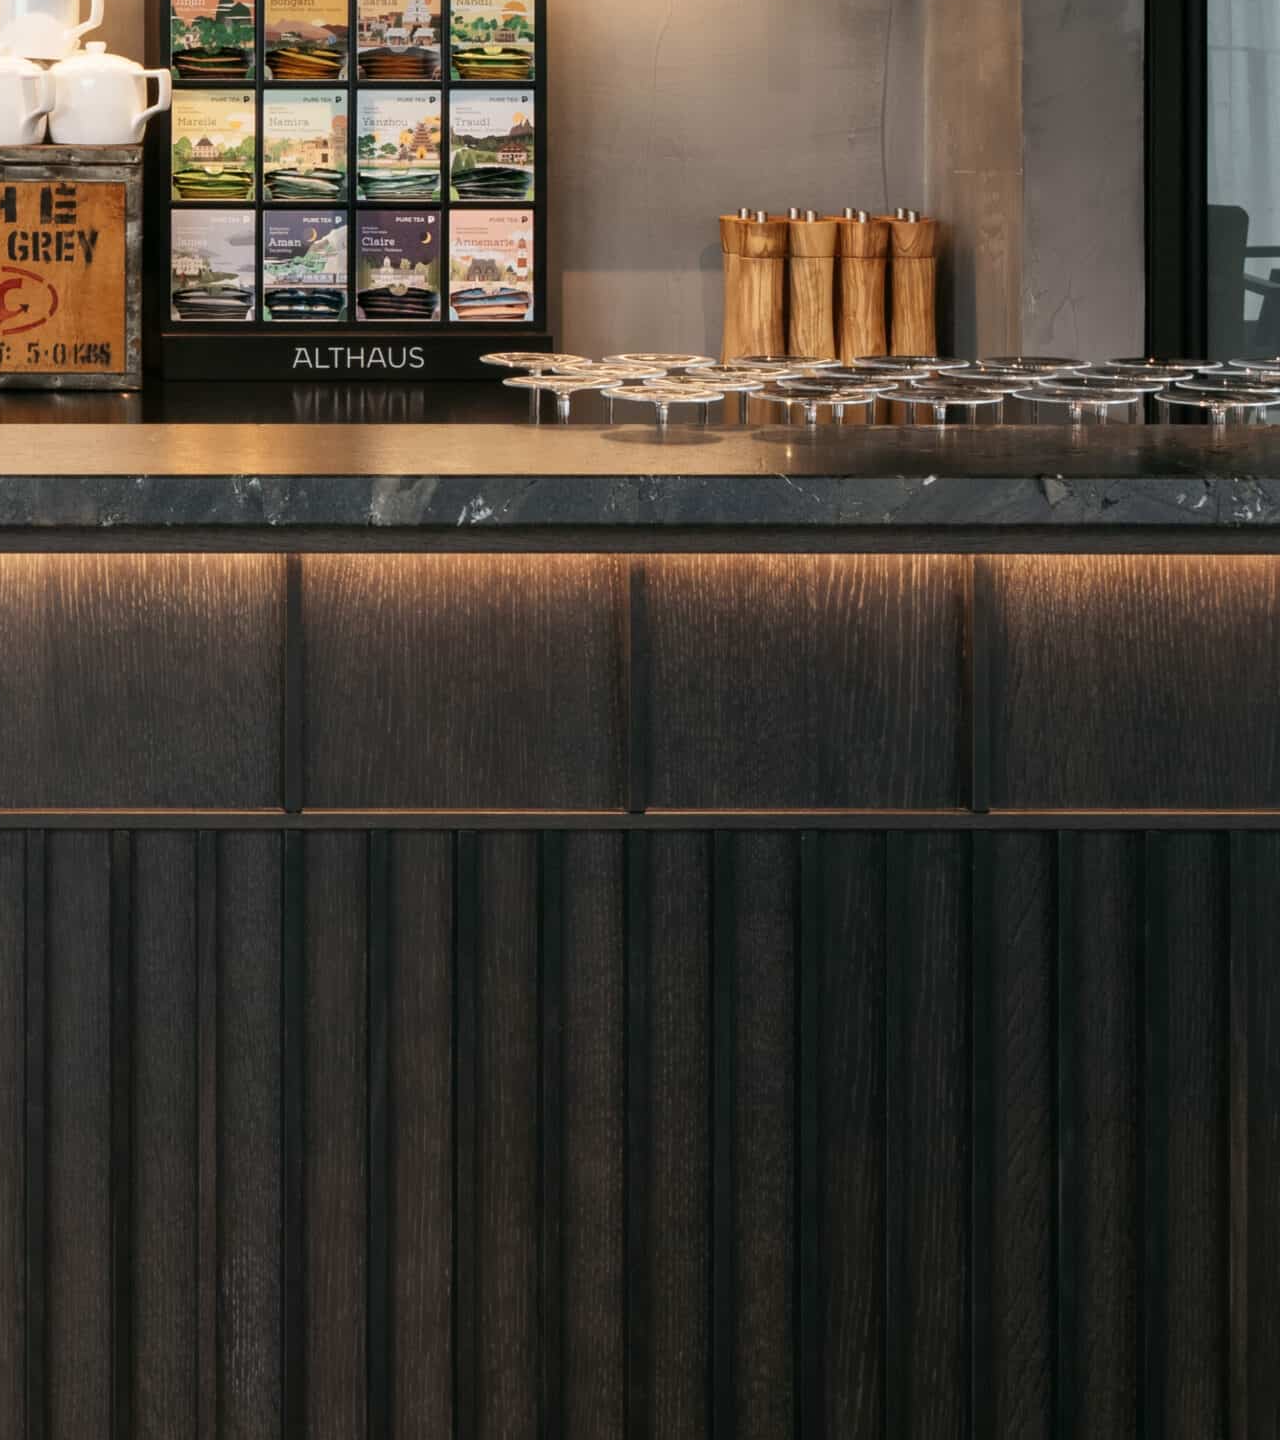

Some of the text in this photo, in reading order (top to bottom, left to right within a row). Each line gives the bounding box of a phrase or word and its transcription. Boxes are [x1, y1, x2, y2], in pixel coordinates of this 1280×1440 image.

[7, 229, 99, 264] GREY
[267, 237, 302, 248] Aman
[361, 236, 396, 247] Claire
[291, 346, 426, 369] ALTHAUS
